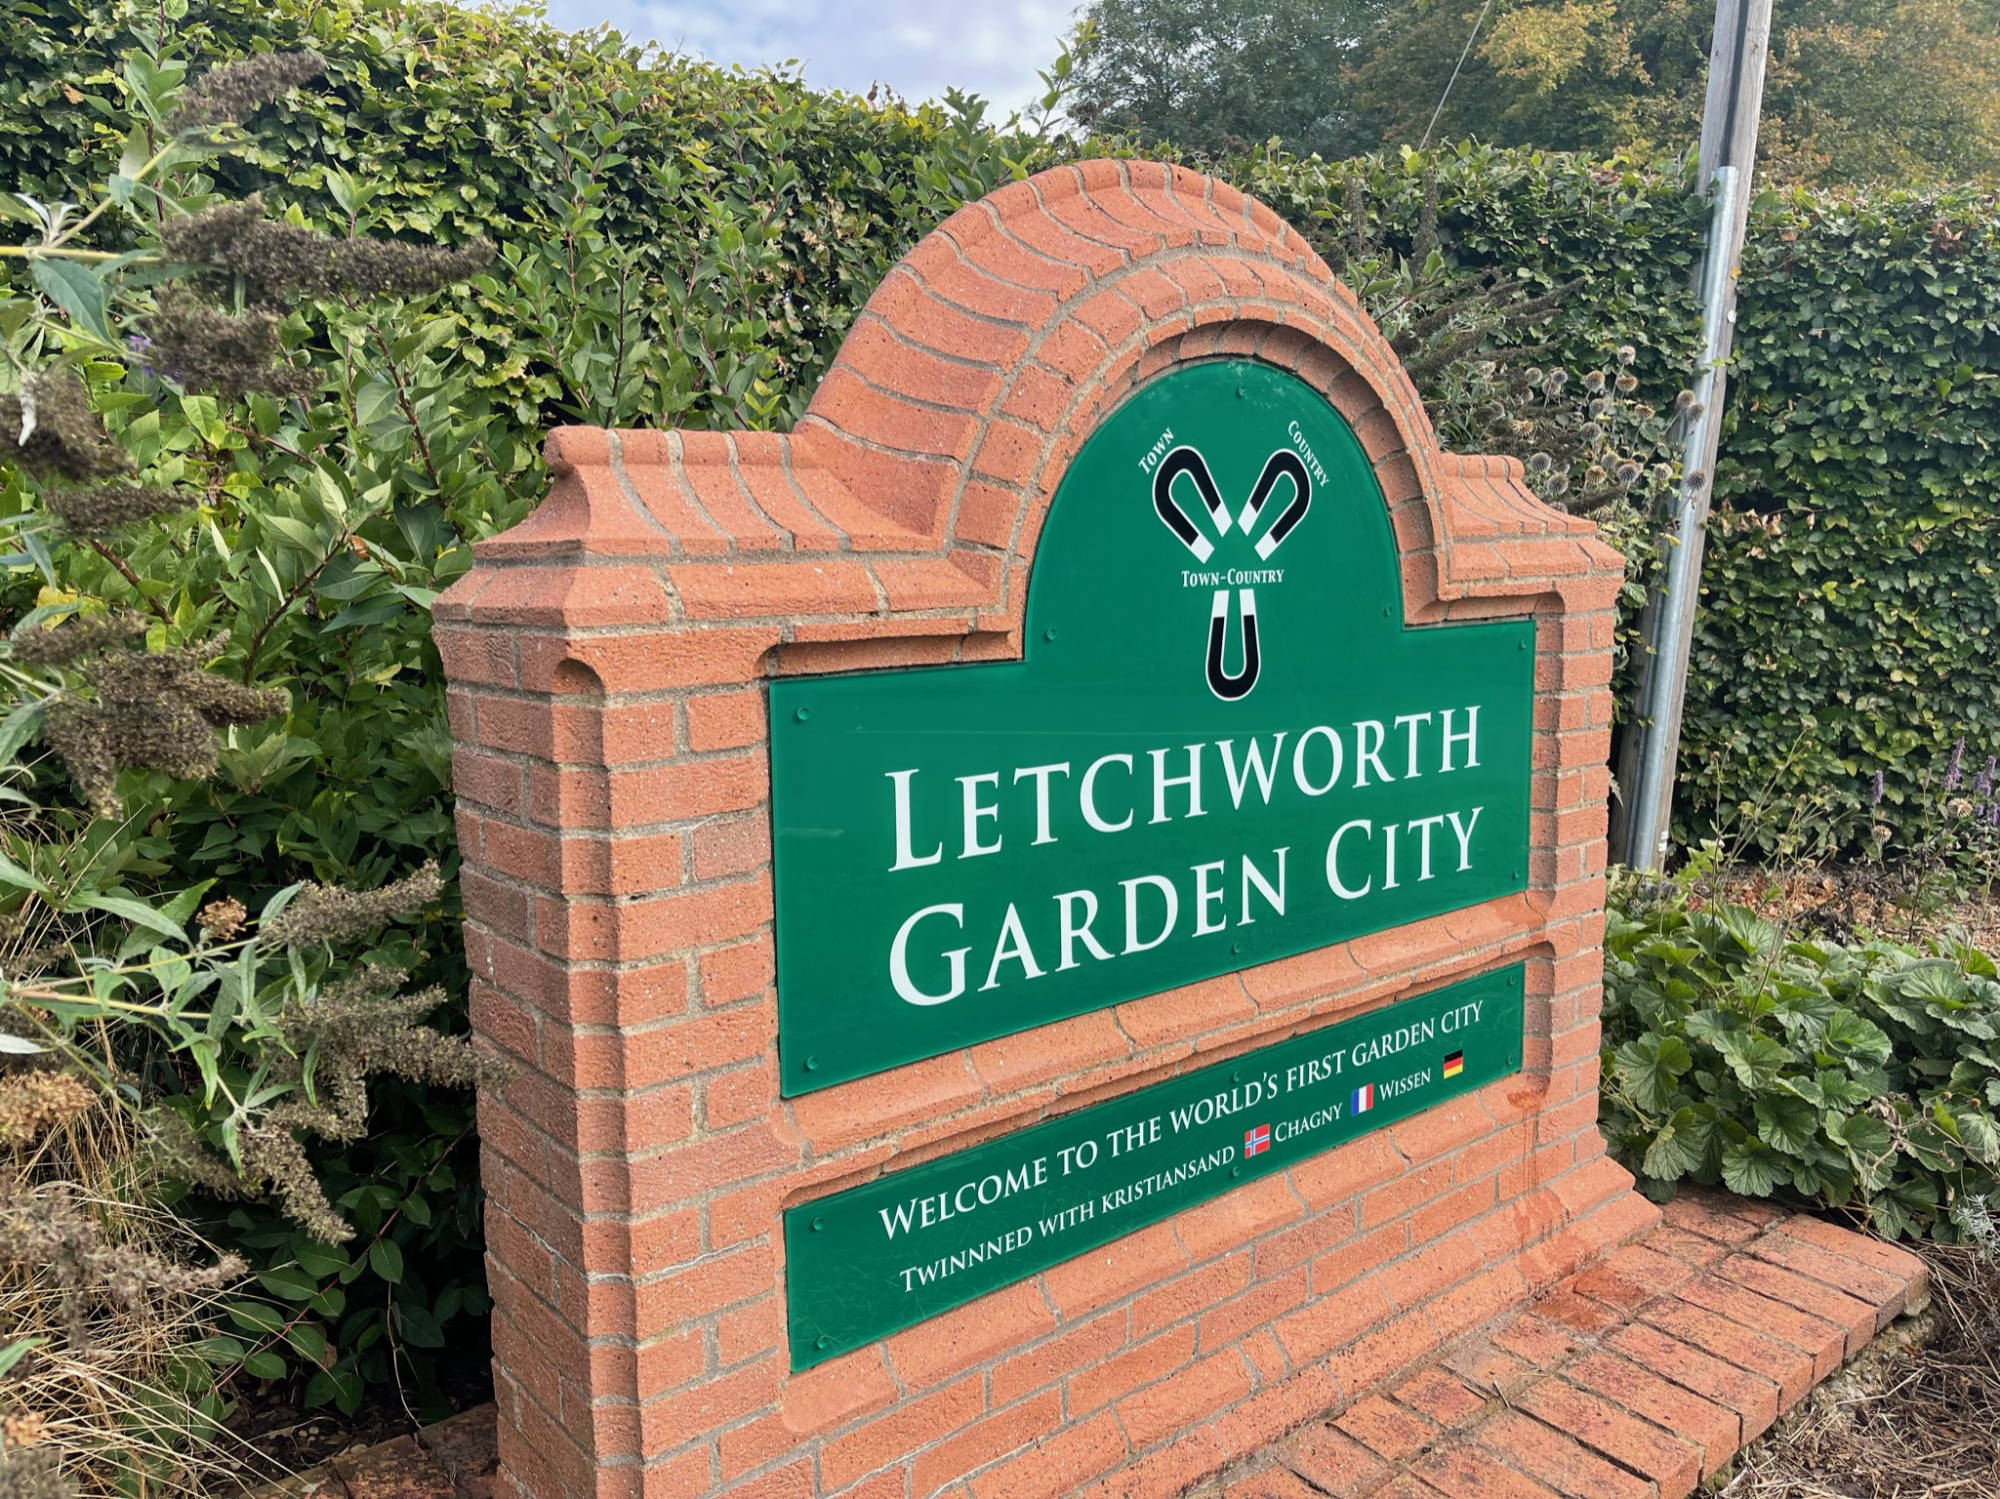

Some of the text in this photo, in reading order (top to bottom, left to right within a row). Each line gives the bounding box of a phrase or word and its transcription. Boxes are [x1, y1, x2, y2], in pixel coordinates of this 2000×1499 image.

[1137, 427, 1175, 475] TOWN
[1287, 420, 1330, 488] COUNTRY
[1181, 568, 1285, 588] TOWN-COUNTRY
[884, 704, 1482, 873] LETCHWORTH
[888, 806, 1484, 1007] GARDEN CITY
[878, 999, 1483, 1241] WELCOME TO THE WORLD'S FIRST GARDEN CITY
[899, 1068, 1432, 1293] TWINNNED WITH KRISTIANSAND CHAGNY WISSEN
